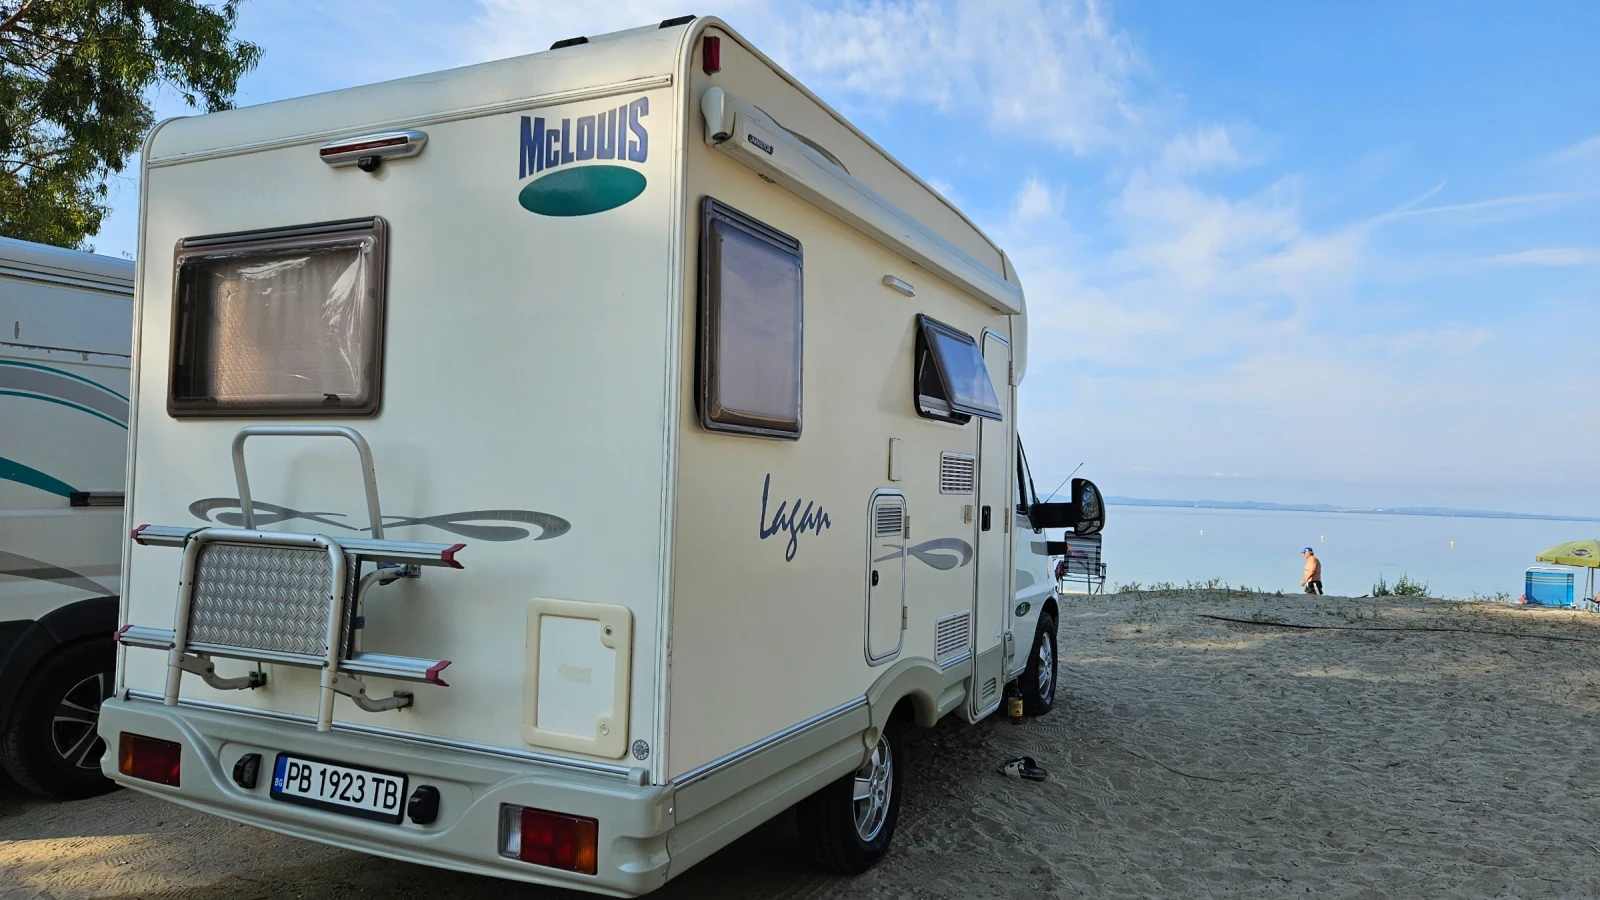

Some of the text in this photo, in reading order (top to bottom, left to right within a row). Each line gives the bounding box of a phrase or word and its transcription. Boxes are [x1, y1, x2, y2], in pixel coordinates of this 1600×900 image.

[760, 473, 831, 562] Lagan
[274, 777, 284, 787] BG
[286, 762, 398, 810] PB 1923 TB
